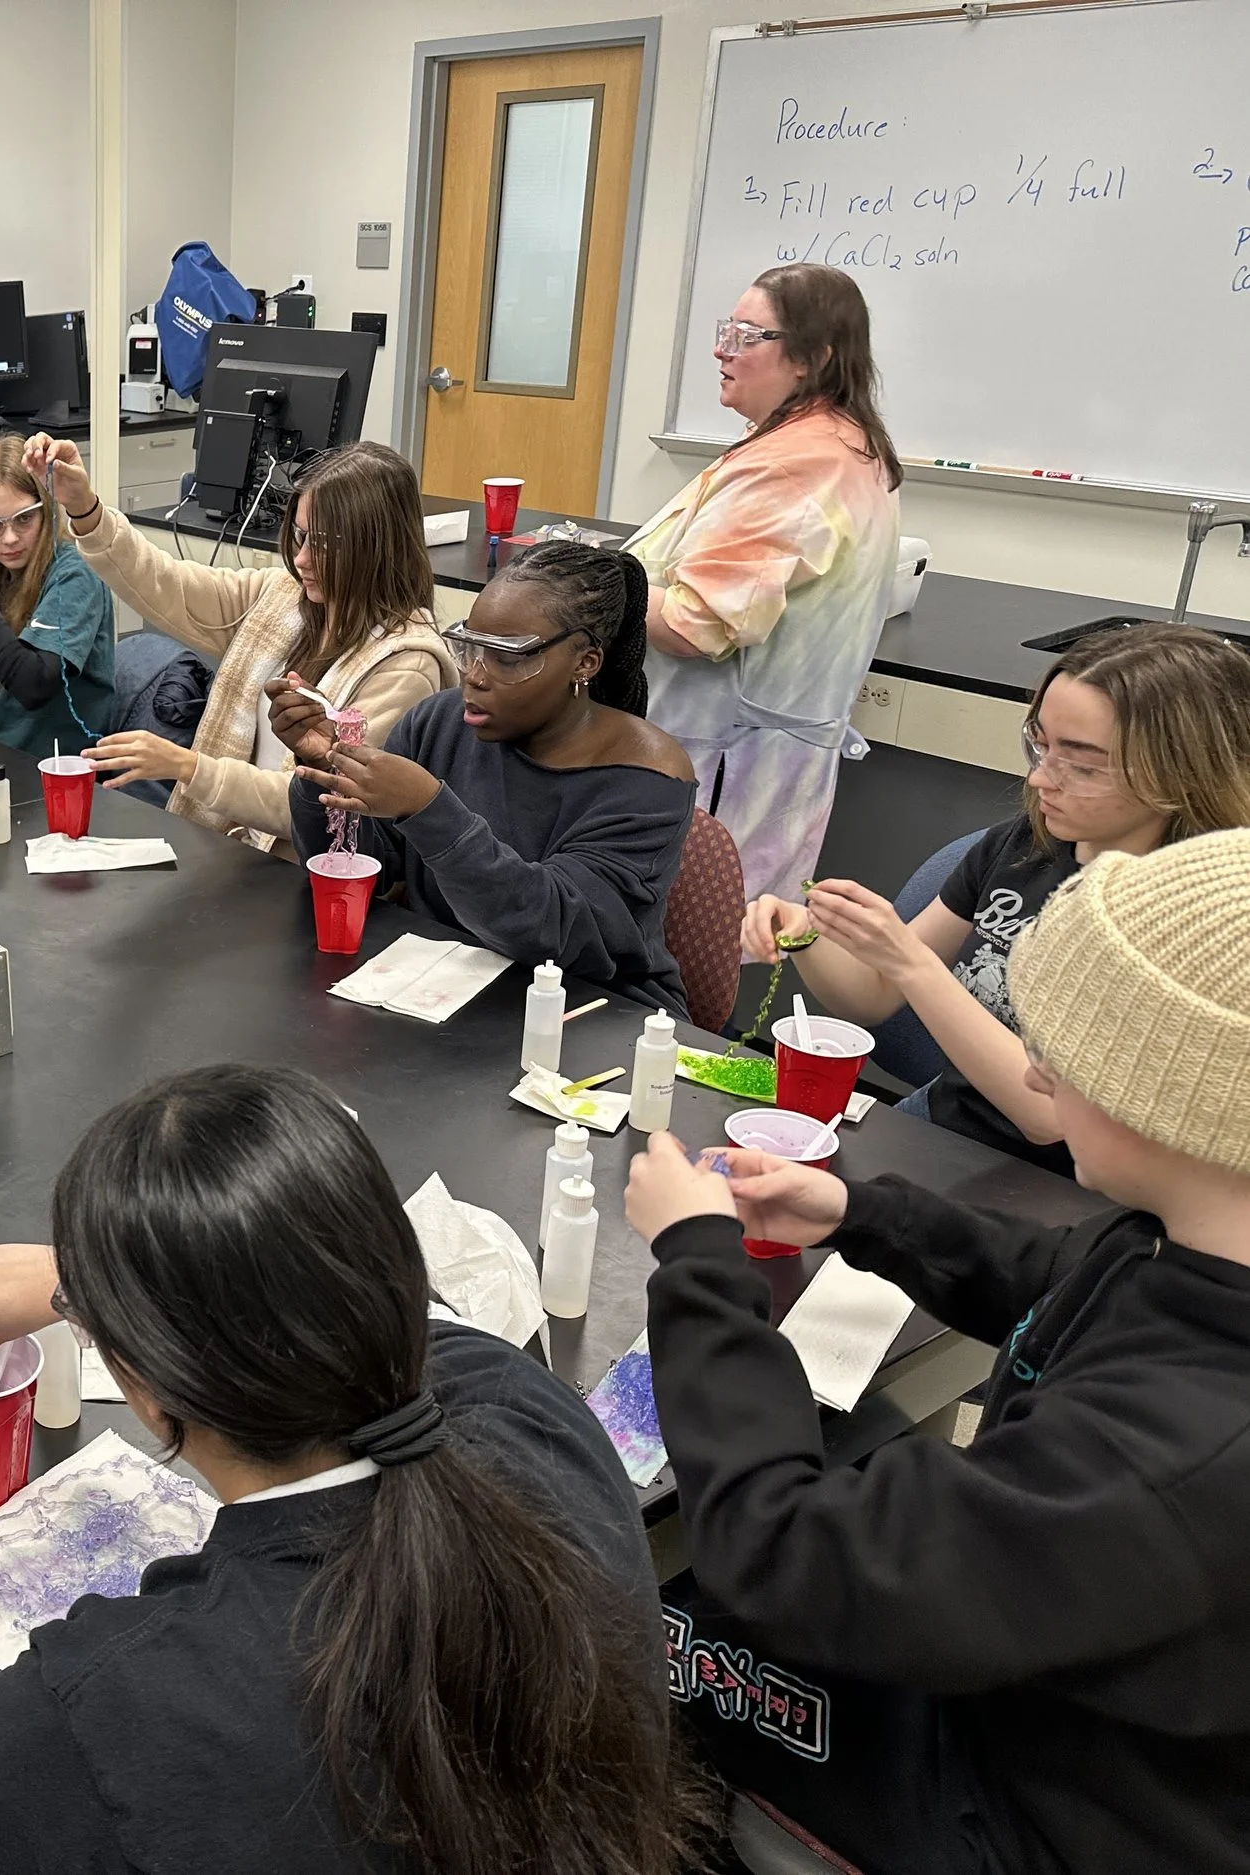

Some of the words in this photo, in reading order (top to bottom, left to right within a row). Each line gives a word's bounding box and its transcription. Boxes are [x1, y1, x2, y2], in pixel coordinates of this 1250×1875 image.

[779, 180, 827, 221] Fill
[848, 185, 894, 216] red
[913, 183, 977, 221] cup
[1068, 158, 1126, 203] full
[172, 296, 214, 330] OLYMPUS
